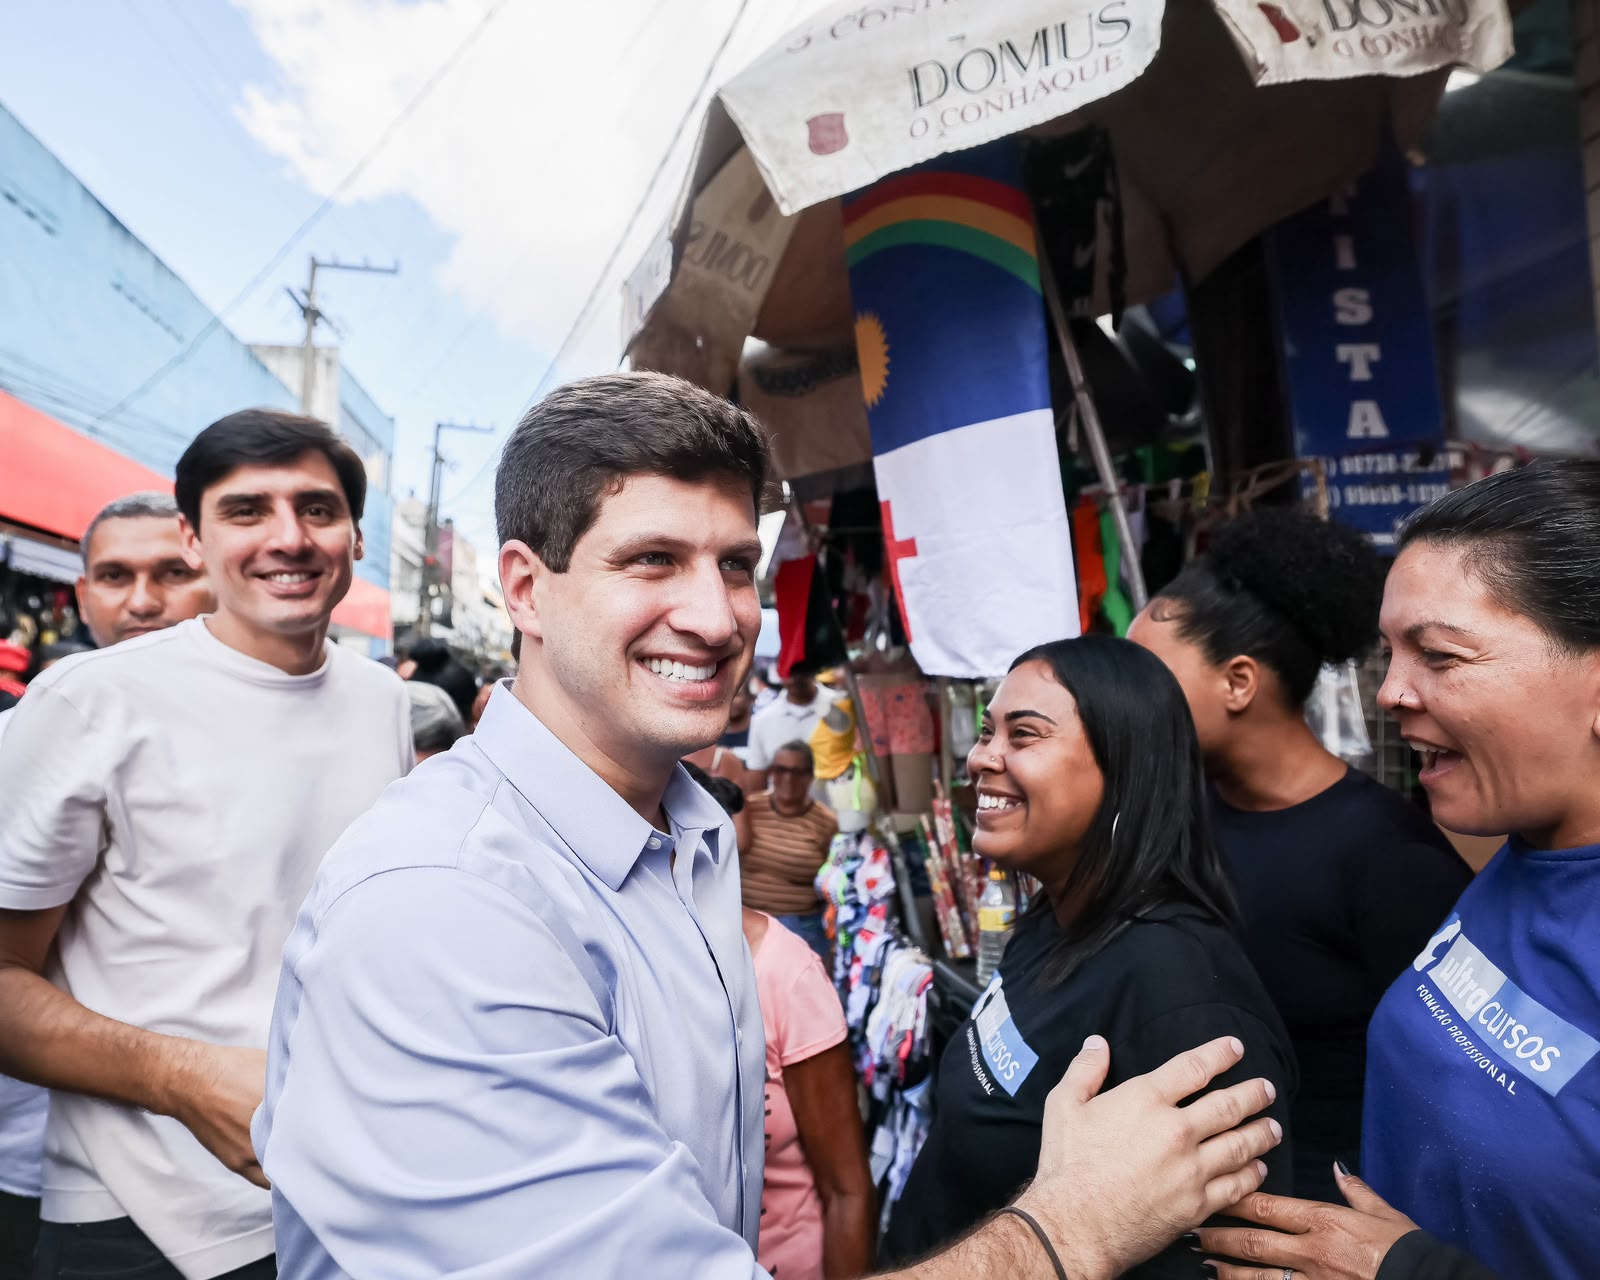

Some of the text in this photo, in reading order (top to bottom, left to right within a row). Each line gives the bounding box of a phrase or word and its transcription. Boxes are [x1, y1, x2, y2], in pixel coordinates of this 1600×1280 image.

[907, 1, 1131, 108] DOMUS
[909, 54, 1124, 139] O CONHAQUE
[1416, 984, 1517, 1095] FORMAÇÃO PROFISSIONAL
